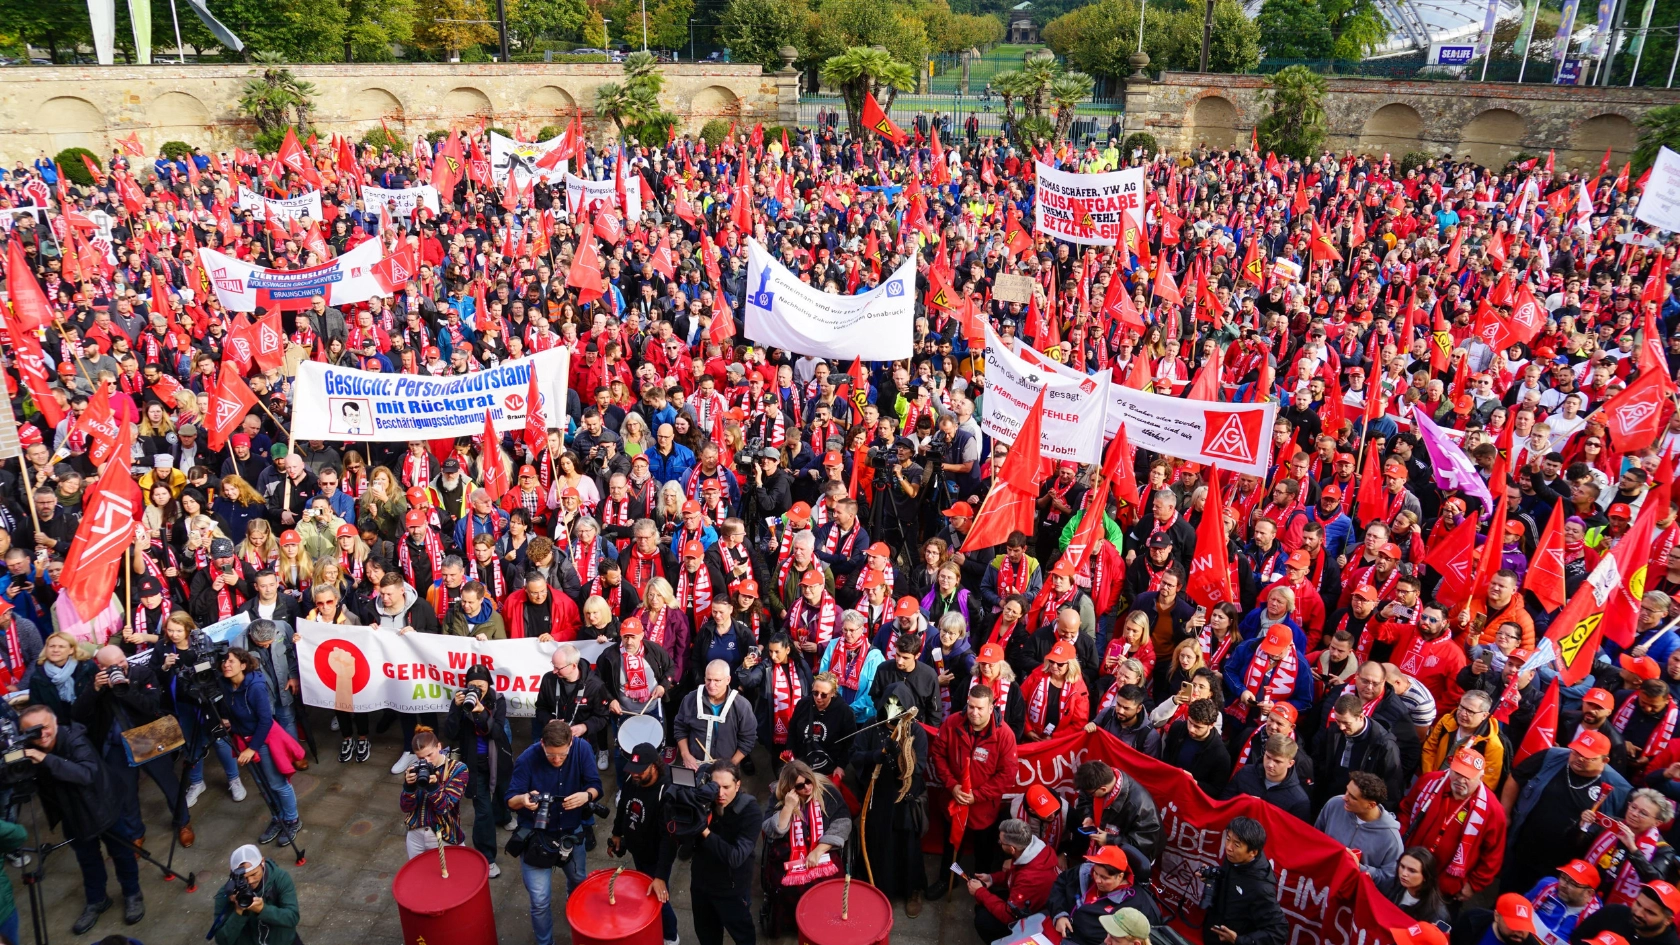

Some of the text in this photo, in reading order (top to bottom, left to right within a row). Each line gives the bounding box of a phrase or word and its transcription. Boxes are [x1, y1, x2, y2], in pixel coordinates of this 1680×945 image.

[1441, 49, 1455, 59] SEA
[1039, 175, 1136, 197] THOMAS SCHÄFER, VW AG
[397, 192, 411, 200] der
[1041, 204, 1069, 220] THEMA
[253, 264, 338, 280] VERTRAUENSLEUTE
[250, 274, 342, 288] VOLKSWAGEN GROUP SERVICES
[273, 288, 322, 298] BRAUNSCHWEIG
[815, 300, 830, 312] sind
[831, 307, 843, 315] wir
[324, 369, 391, 397] Gesucht:
[376, 393, 496, 414] mit Rückgrat
[1049, 390, 1082, 402] gesagt:
[991, 423, 1018, 440] endlic
[1050, 444, 1077, 456] Job!!!
[447, 650, 495, 671] WIR
[382, 661, 542, 693] GEHÖRE DAZ
[383, 699, 444, 712] SOLIDARISCH
